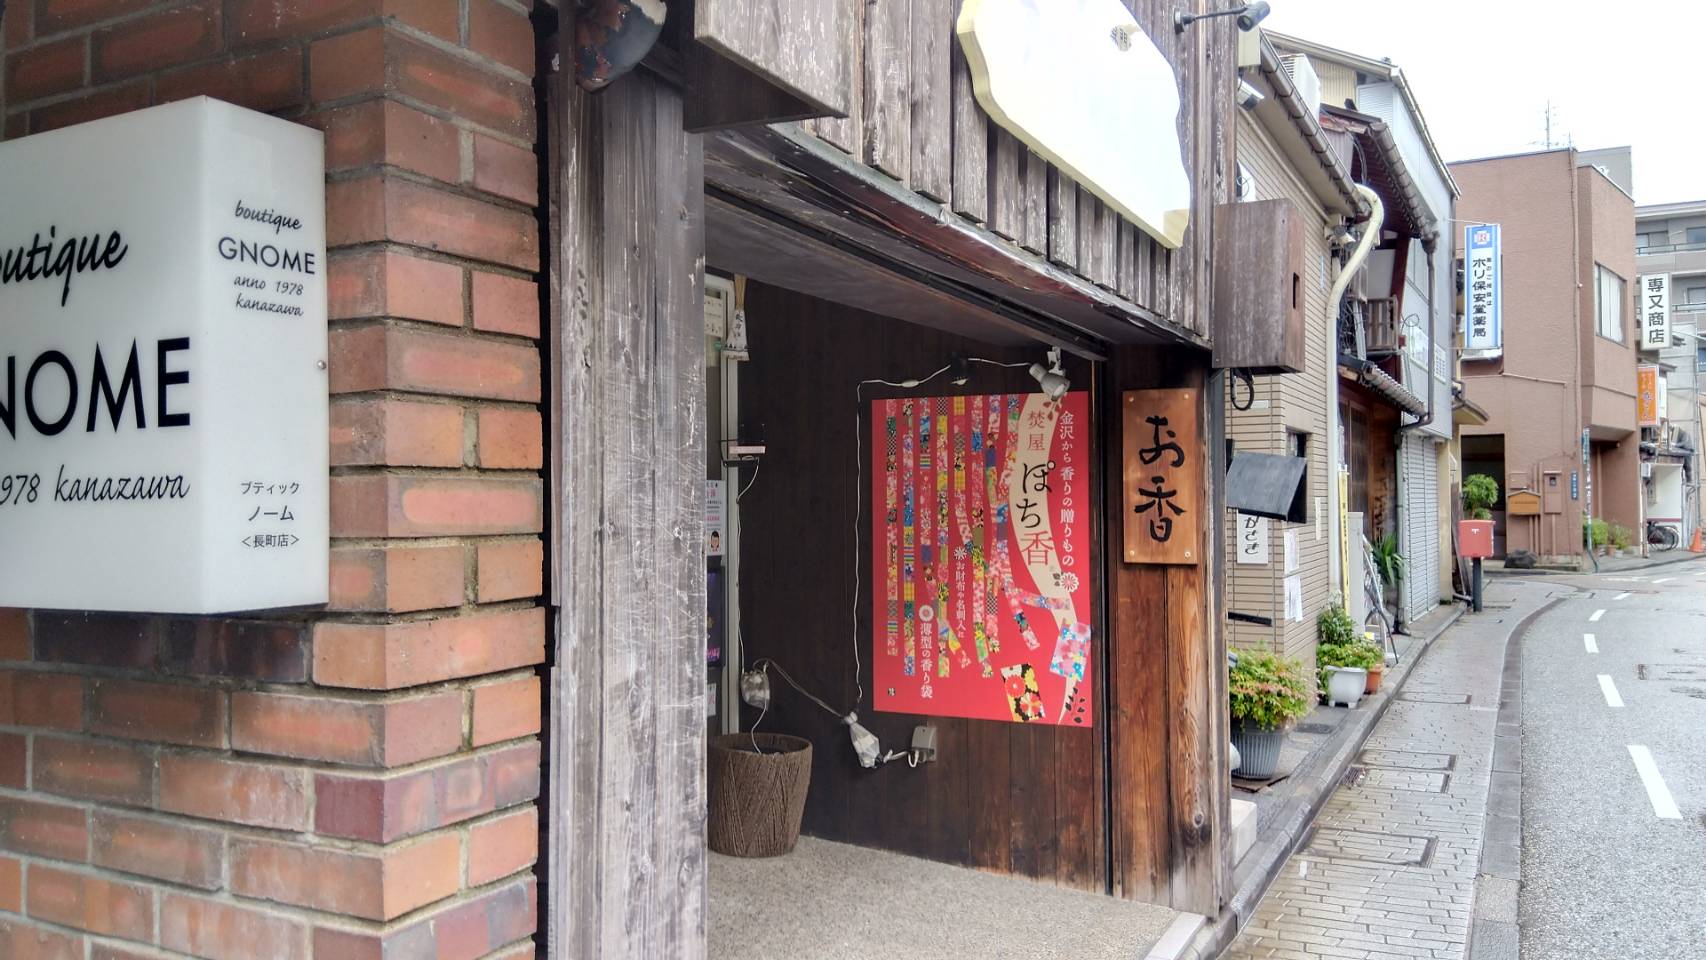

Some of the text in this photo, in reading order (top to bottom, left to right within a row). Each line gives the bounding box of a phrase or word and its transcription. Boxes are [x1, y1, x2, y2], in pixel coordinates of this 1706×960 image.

[235, 199, 303, 235] boutique
[0, 225, 129, 307] utique
[218, 236, 316, 275] GNOME
[233, 276, 304, 296] anno 1978
[235, 292, 304, 317] kanazawa
[1647, 276, 1665, 344] 専又商店
[54, 464, 191, 503] kanazawa
[240, 480, 300, 495] ブティック
[1059, 410, 1076, 568] 金沢から香りの贈りもの
[1134, 414, 1187, 543] お香
[247, 504, 295, 522] ノーム
[1016, 460, 1056, 567] ぽち香
[920, 622, 933, 699] 薄型の香り袋
